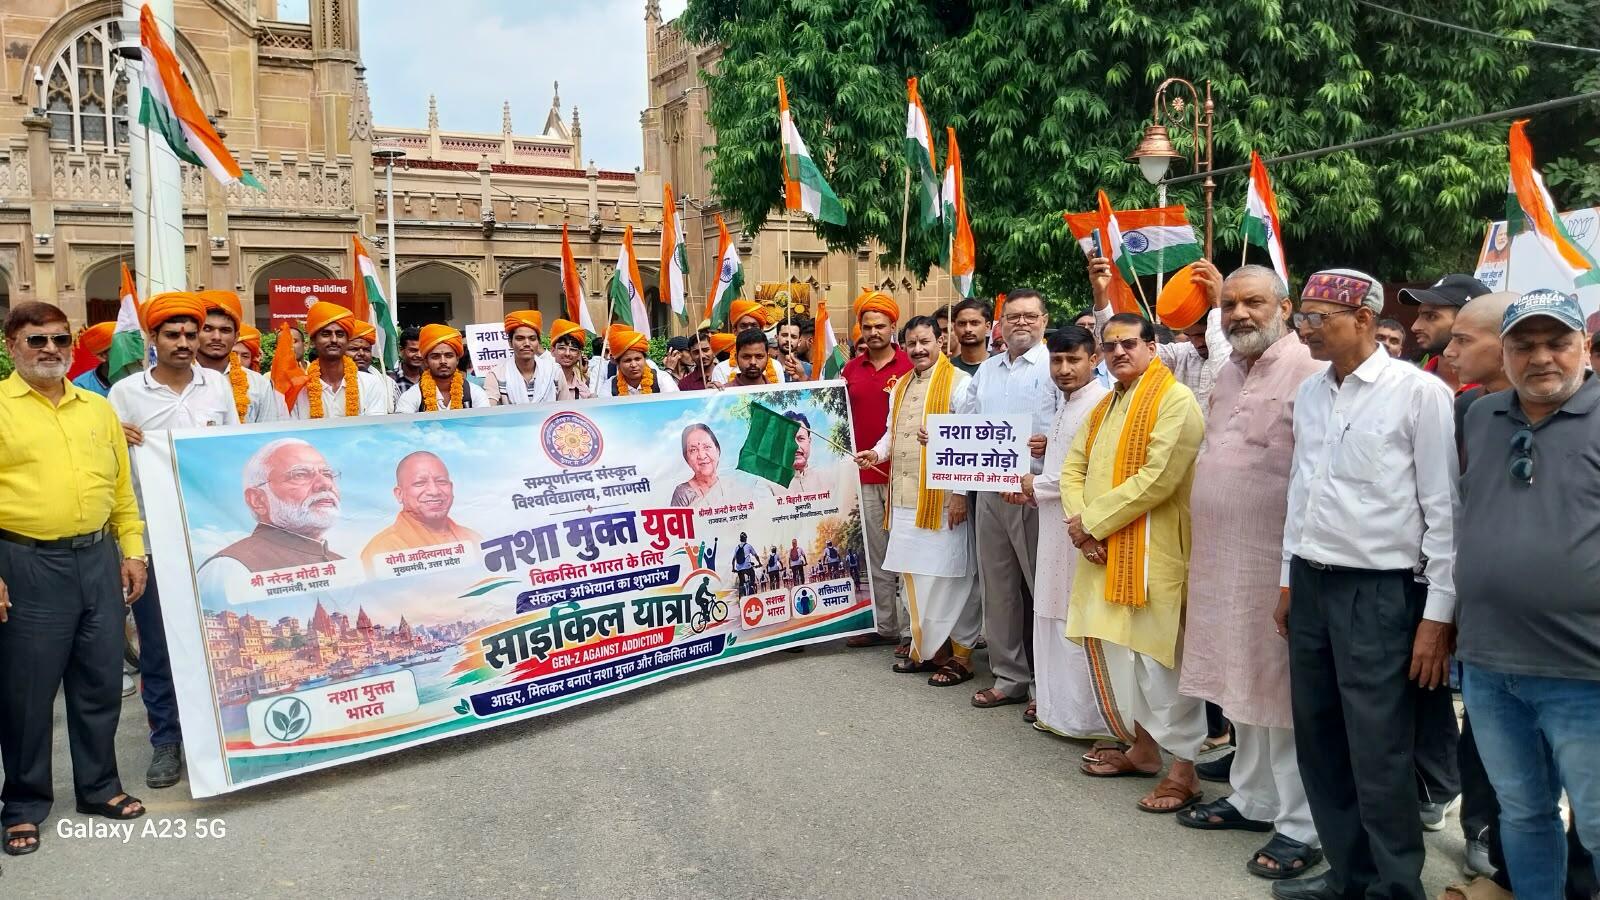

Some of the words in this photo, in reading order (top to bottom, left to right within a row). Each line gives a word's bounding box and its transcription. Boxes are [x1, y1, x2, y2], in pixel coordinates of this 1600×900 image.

[275, 284, 311, 294] Heritage
[313, 284, 348, 294] Building
[475, 331, 499, 342] नशा
[476, 347, 507, 361] जीवन
[939, 425, 971, 440] नशा
[975, 421, 1016, 444] छोड़ो,
[936, 448, 978, 467] जीवन
[981, 448, 1018, 472] जोड़ो
[523, 470, 594, 490] सम्पूर्णानन्द
[596, 465, 637, 480] संस्कृत
[954, 474, 972, 482] भारत
[974, 472, 984, 482] की
[512, 487, 600, 510] विश्वविद्यालय,
[601, 477, 651, 497] वाराणसी
[481, 524, 561, 573] नशा
[563, 511, 639, 561] मुक्त
[641, 509, 695, 550] युवा
[385, 553, 406, 565] योगी
[408, 548, 452, 562] आदित्यनाथ
[454, 544, 465, 554] जी
[444, 557, 460, 567] प्रदेश
[250, 571, 264, 587] श्री
[267, 569, 293, 586] नरेन्द्र
[296, 566, 321, 581] मोदी
[322, 565, 337, 576] जी
[529, 563, 588, 586] विकसित
[590, 556, 624, 574] भारत
[626, 553, 639, 569] के
[641, 550, 664, 567] लिए
[308, 579, 330, 590] भारत
[529, 588, 567, 606] संकल्प
[617, 577, 631, 589] का
[633, 570, 670, 589] शुभारंभ
[823, 594, 849, 607] समाज
[767, 606, 786, 617] भारत
[482, 599, 625, 669] साइकिल
[633, 593, 694, 628] यात्रा
[552, 651, 581, 670] GEN-Z
[583, 643, 620, 663] AGAINST
[622, 632, 664, 652] ADDICTION
[491, 689, 526, 708] आइए,
[527, 681, 565, 699] मिलकर
[567, 672, 592, 689] बनाएं
[594, 667, 613, 681] नशा
[637, 655, 652, 669] और
[654, 648, 687, 666] विकसित
[689, 640, 713, 656] भारत!
[327, 688, 358, 705] नशा
[346, 702, 385, 720] भारत
